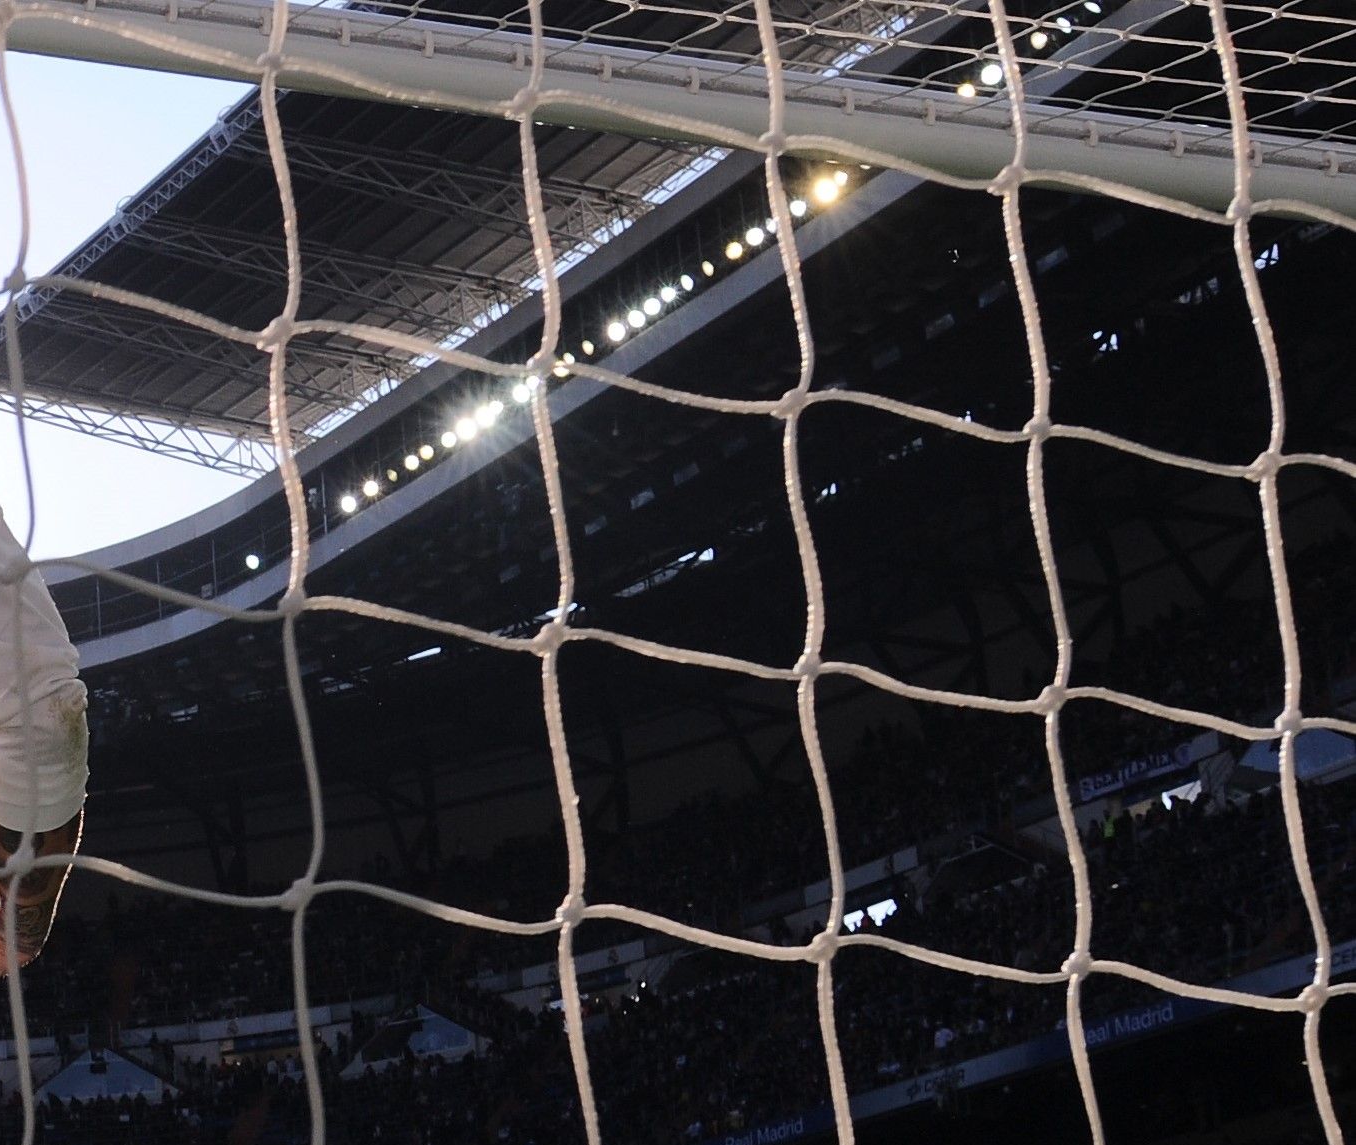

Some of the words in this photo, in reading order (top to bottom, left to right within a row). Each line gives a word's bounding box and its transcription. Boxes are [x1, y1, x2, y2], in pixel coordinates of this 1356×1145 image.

[1084, 1021, 1111, 1045] eal
[1115, 1002, 1174, 1035] Madrid
[757, 1117, 804, 1145] Madrid
